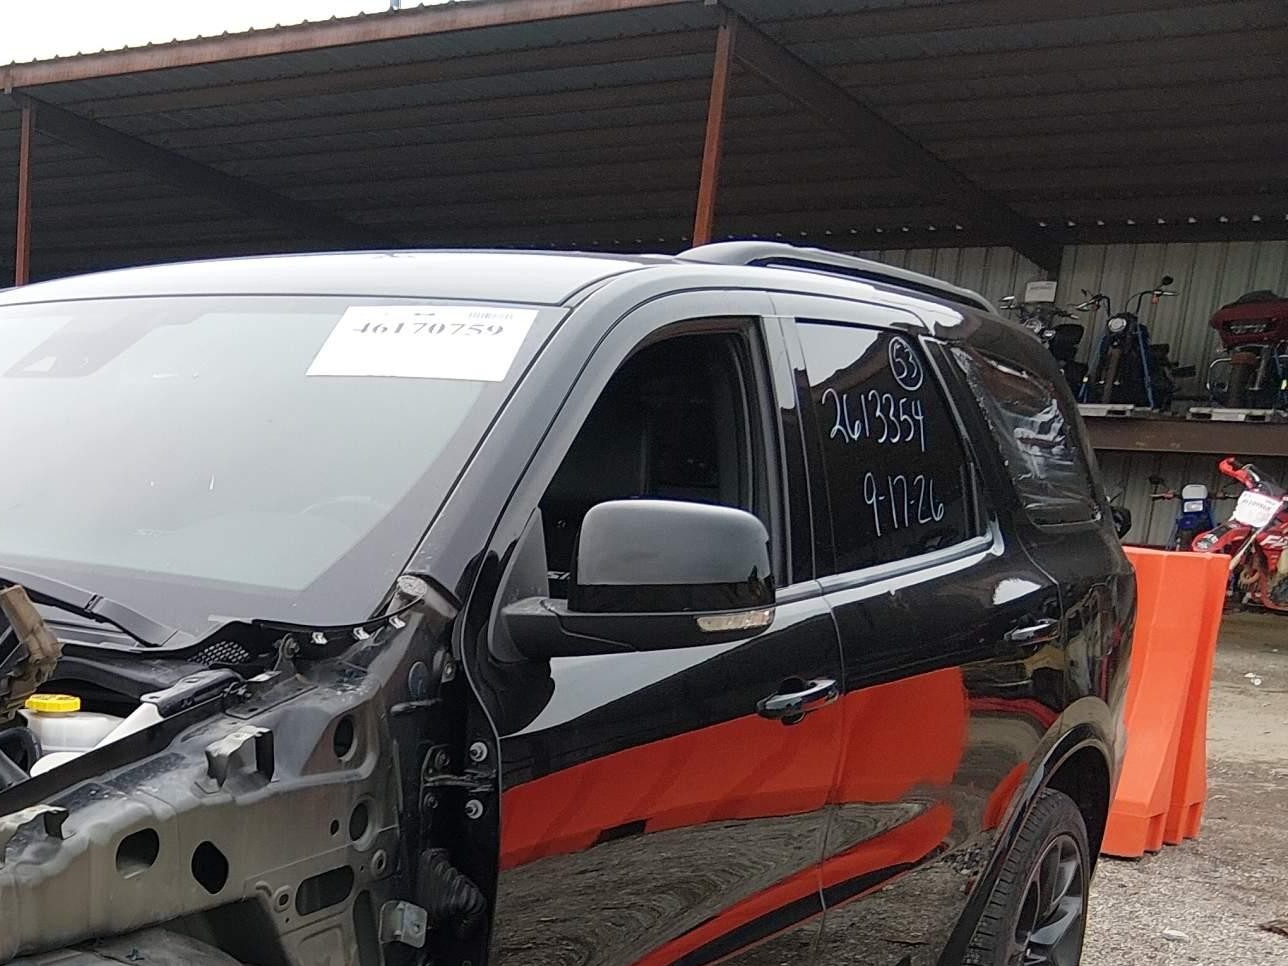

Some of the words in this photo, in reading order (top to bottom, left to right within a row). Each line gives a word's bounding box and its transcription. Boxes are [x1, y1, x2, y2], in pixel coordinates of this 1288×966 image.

[353, 322, 504, 336] 46170759
[821, 388, 924, 452] 2613354
[863, 472, 944, 537] 9-17-26
